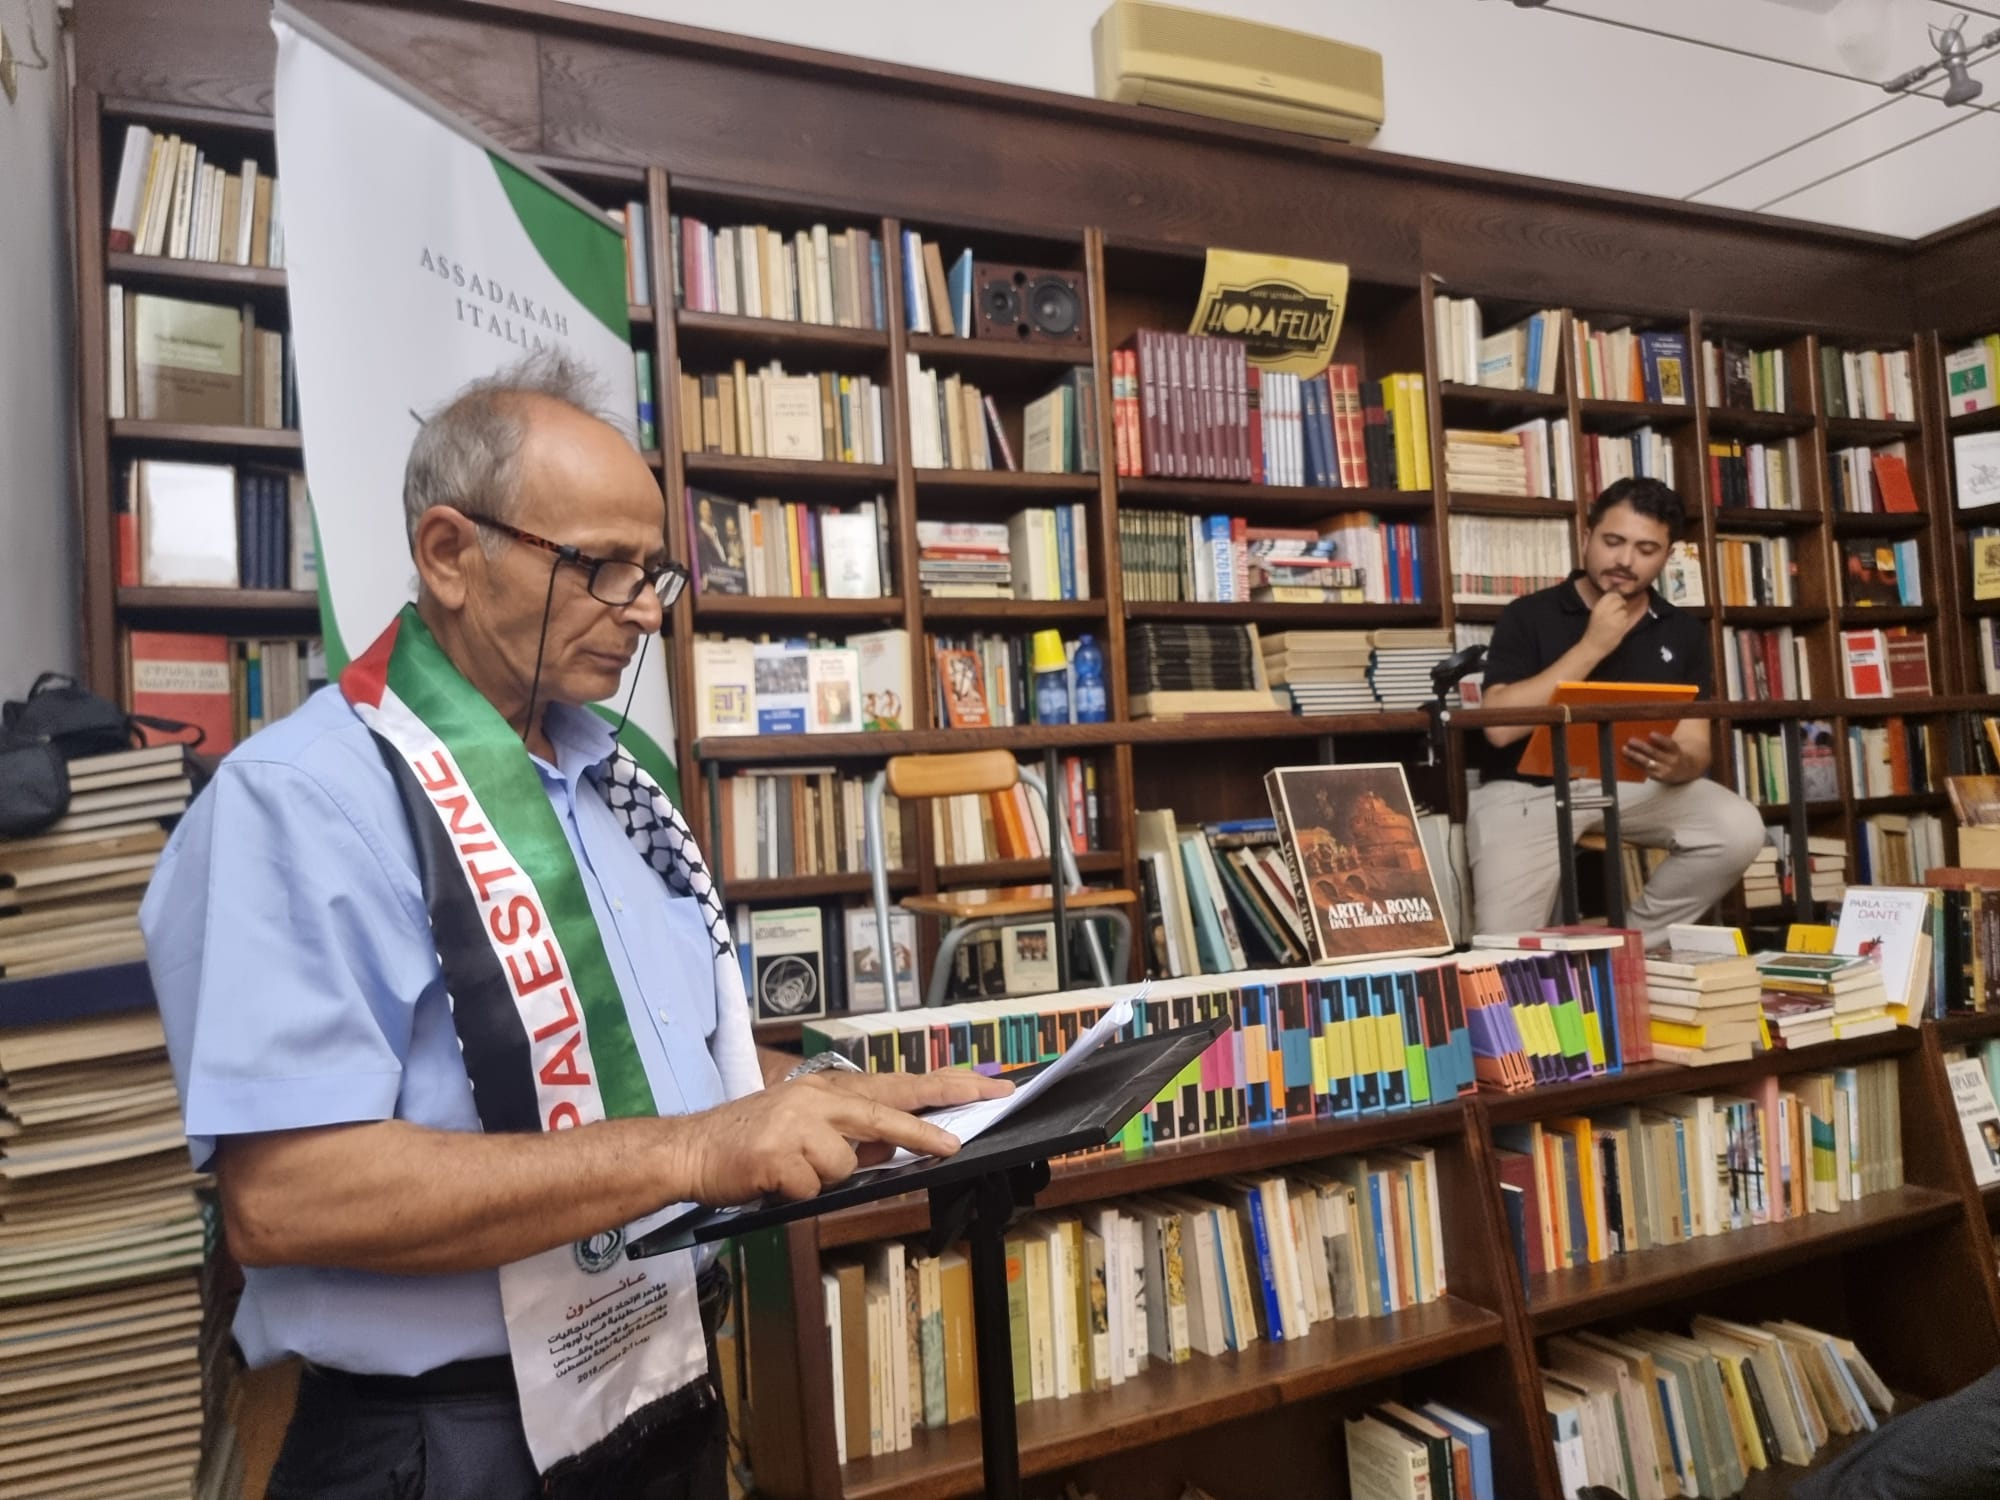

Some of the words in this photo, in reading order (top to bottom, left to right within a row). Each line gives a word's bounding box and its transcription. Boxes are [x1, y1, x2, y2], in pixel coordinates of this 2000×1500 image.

[420, 247, 569, 336] ASSADAKAH
[456, 298, 544, 352] ITALIA
[1208, 302, 1331, 342] HORAFELIX
[1215, 541, 1230, 569] ENZO
[1328, 902, 1365, 920] ARTE
[1372, 901, 1383, 915] A
[1386, 897, 1431, 914] ROMA
[1850, 899, 1880, 908] PARLA
[1858, 909, 1900, 921] DANTE
[1329, 916, 1352, 930] DAL
[1353, 913, 1396, 929] LIBERTY
[1396, 912, 1407, 925] A
[1406, 910, 1434, 923] OGGI
[414, 750, 591, 1131] PALESTINE
